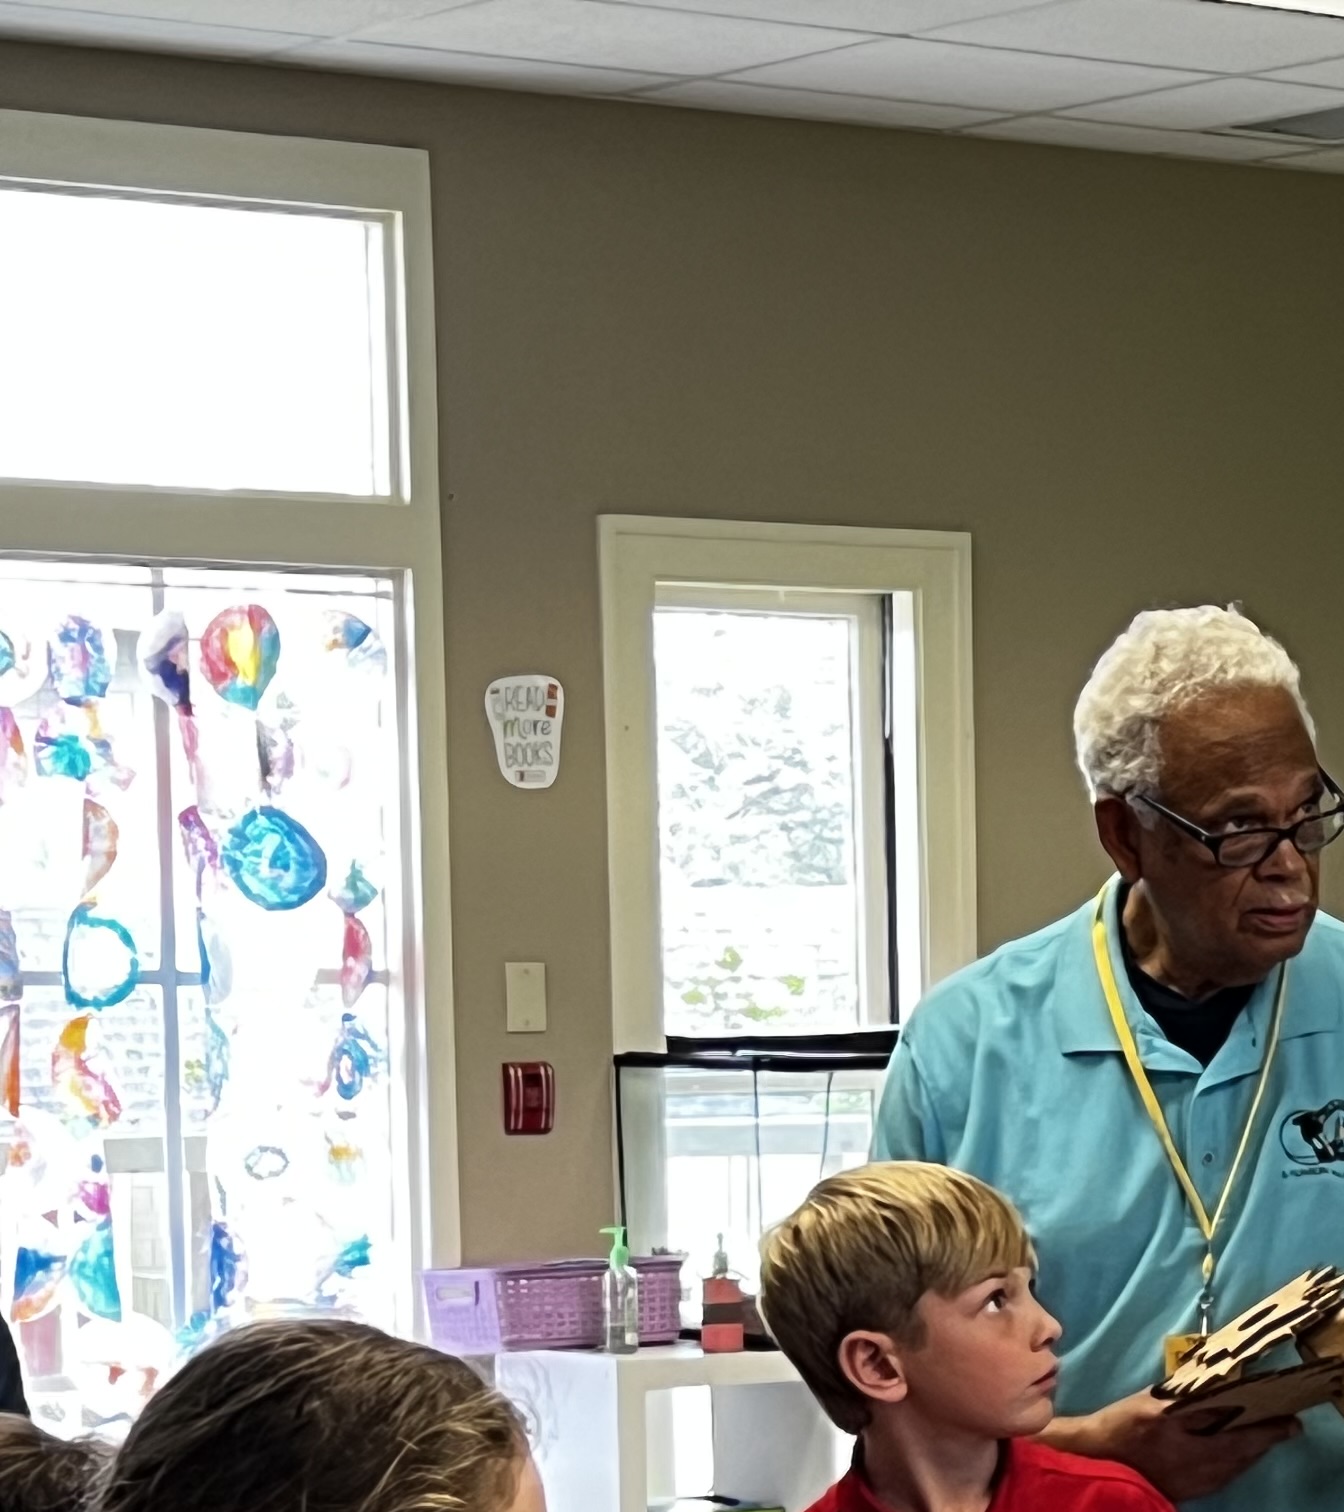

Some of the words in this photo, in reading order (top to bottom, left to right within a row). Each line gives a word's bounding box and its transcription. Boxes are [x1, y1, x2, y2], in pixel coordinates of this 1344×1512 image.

[505, 686, 546, 712] READ
[503, 717, 552, 739] more
[504, 741, 553, 768] BOOKS
